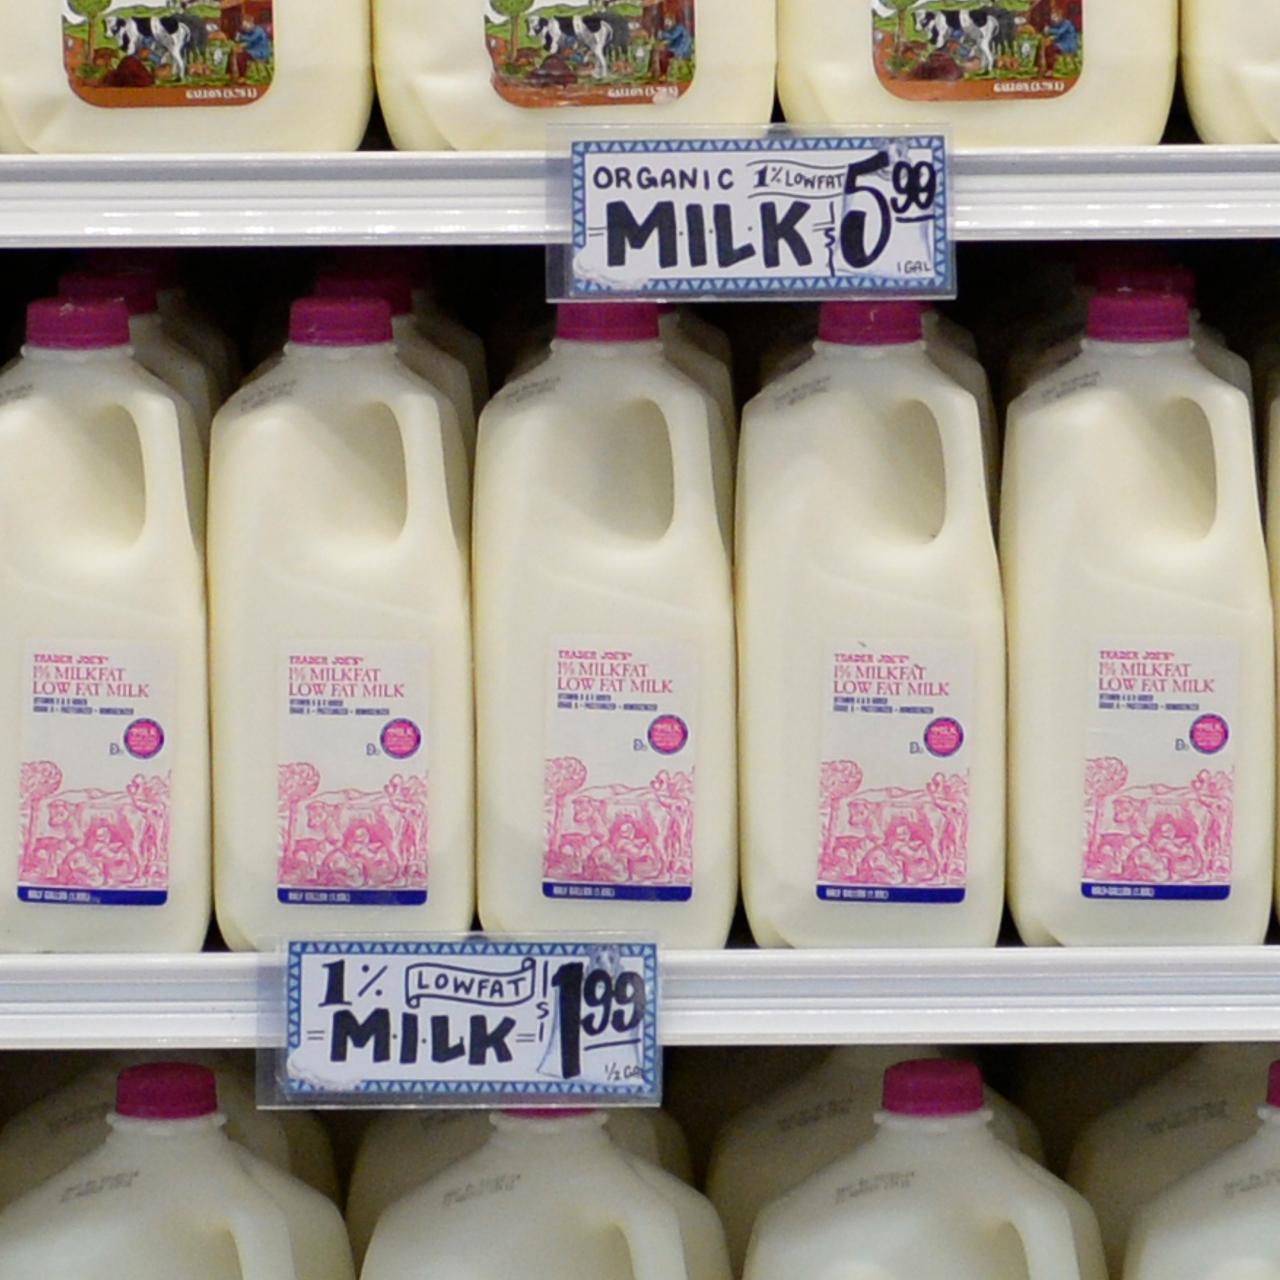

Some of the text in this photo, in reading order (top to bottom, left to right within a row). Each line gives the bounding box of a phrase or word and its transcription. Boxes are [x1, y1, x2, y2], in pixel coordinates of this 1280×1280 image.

[593, 167, 735, 191] ORGANIC
[751, 165, 783, 190] 1%
[1120, 663, 1191, 677] MILKFAT
[1098, 678, 1215, 693] LOW FAT MILK
[318, 959, 526, 1008] 1% LOWFAT
